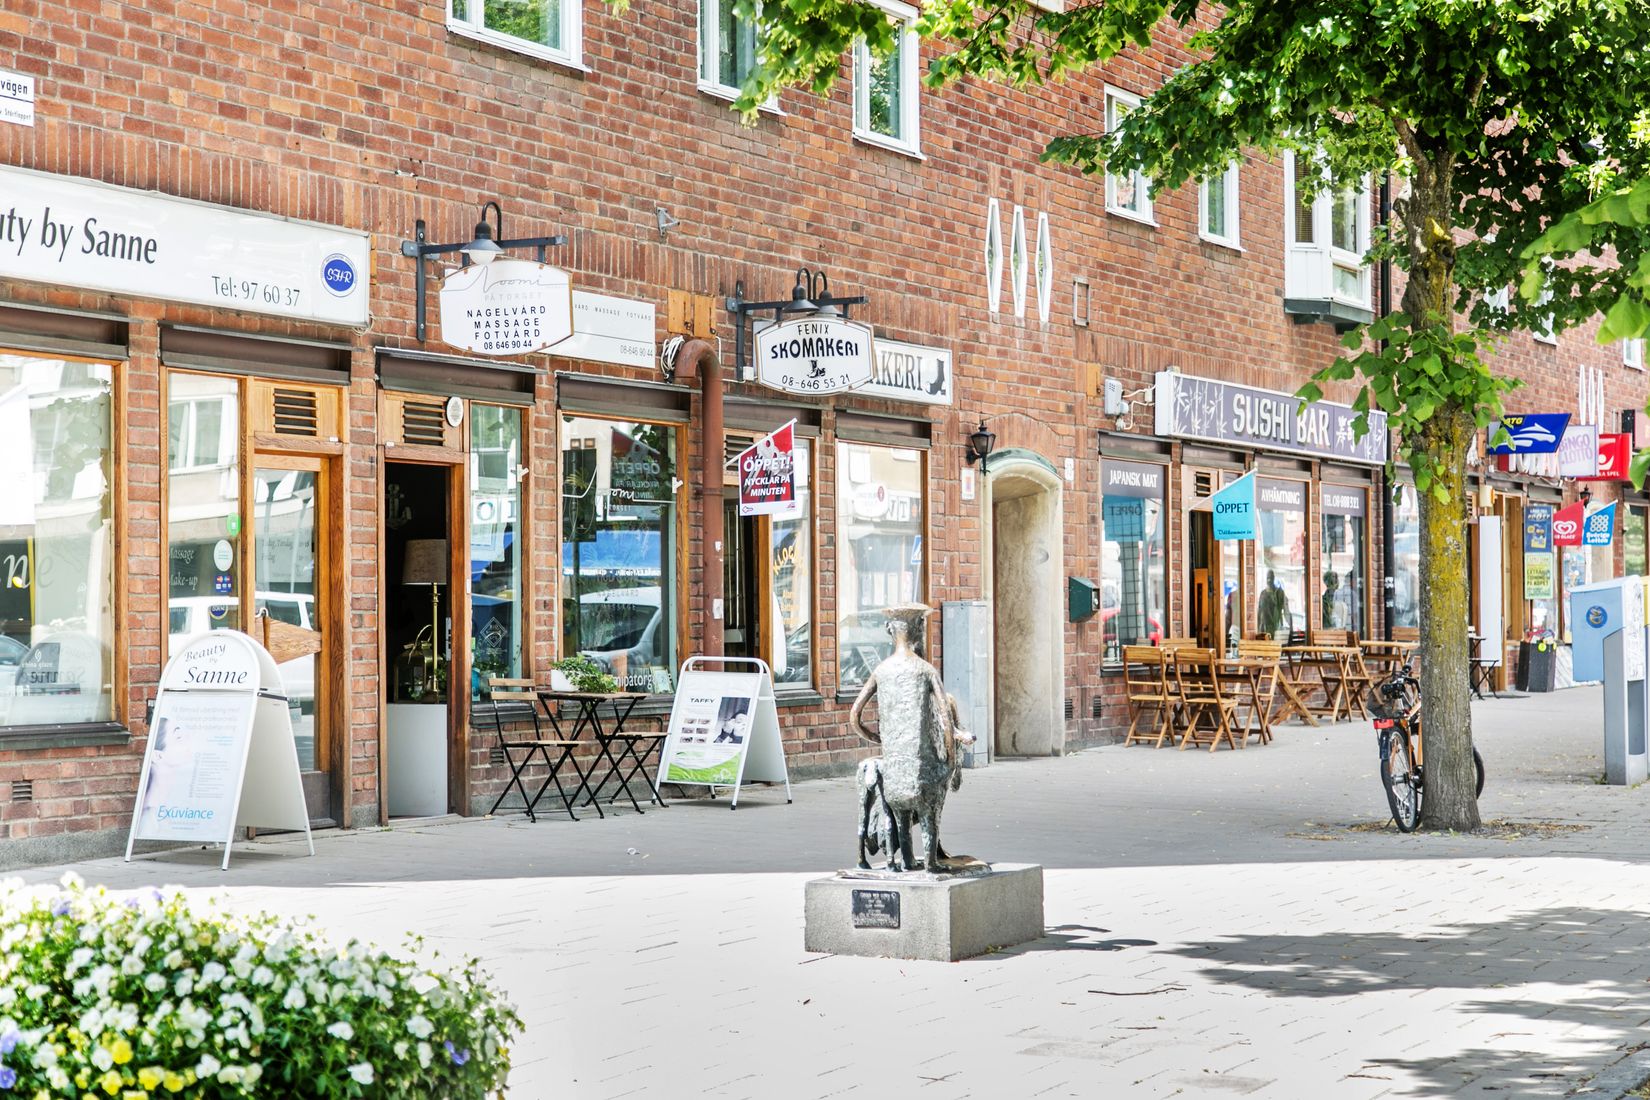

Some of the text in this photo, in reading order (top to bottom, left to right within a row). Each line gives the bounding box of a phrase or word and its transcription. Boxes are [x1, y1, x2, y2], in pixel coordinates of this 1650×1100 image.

[41, 207, 73, 262] by
[82, 217, 157, 264] Sanne
[212, 275, 300, 306] Tel: 97 60 37
[467, 305, 546, 318] NAGELVÅRD
[474, 318, 540, 329] MASSAGE
[797, 323, 829, 336] FENIX
[475, 329, 540, 340] FOTVÅRD
[483, 339, 532, 350] 08 646 90 44
[771, 337, 859, 359] SKOMAKERI
[781, 374, 850, 390] 08-646 55 21
[1232, 393, 1331, 447] SUSHI BAR
[743, 456, 790, 473] ÖPPET!
[745, 474, 790, 486] NYCKLAR PÅ
[1109, 469, 1158, 488] JAPANSK MAT
[750, 487, 786, 497] MINUTEN
[1261, 487, 1300, 505] AVHÄMTNING
[1215, 502, 1250, 514] ÖPPET
[185, 643, 226, 662] Beauty
[184, 666, 248, 684] Sanne
[157, 805, 214, 821] Exuviance
